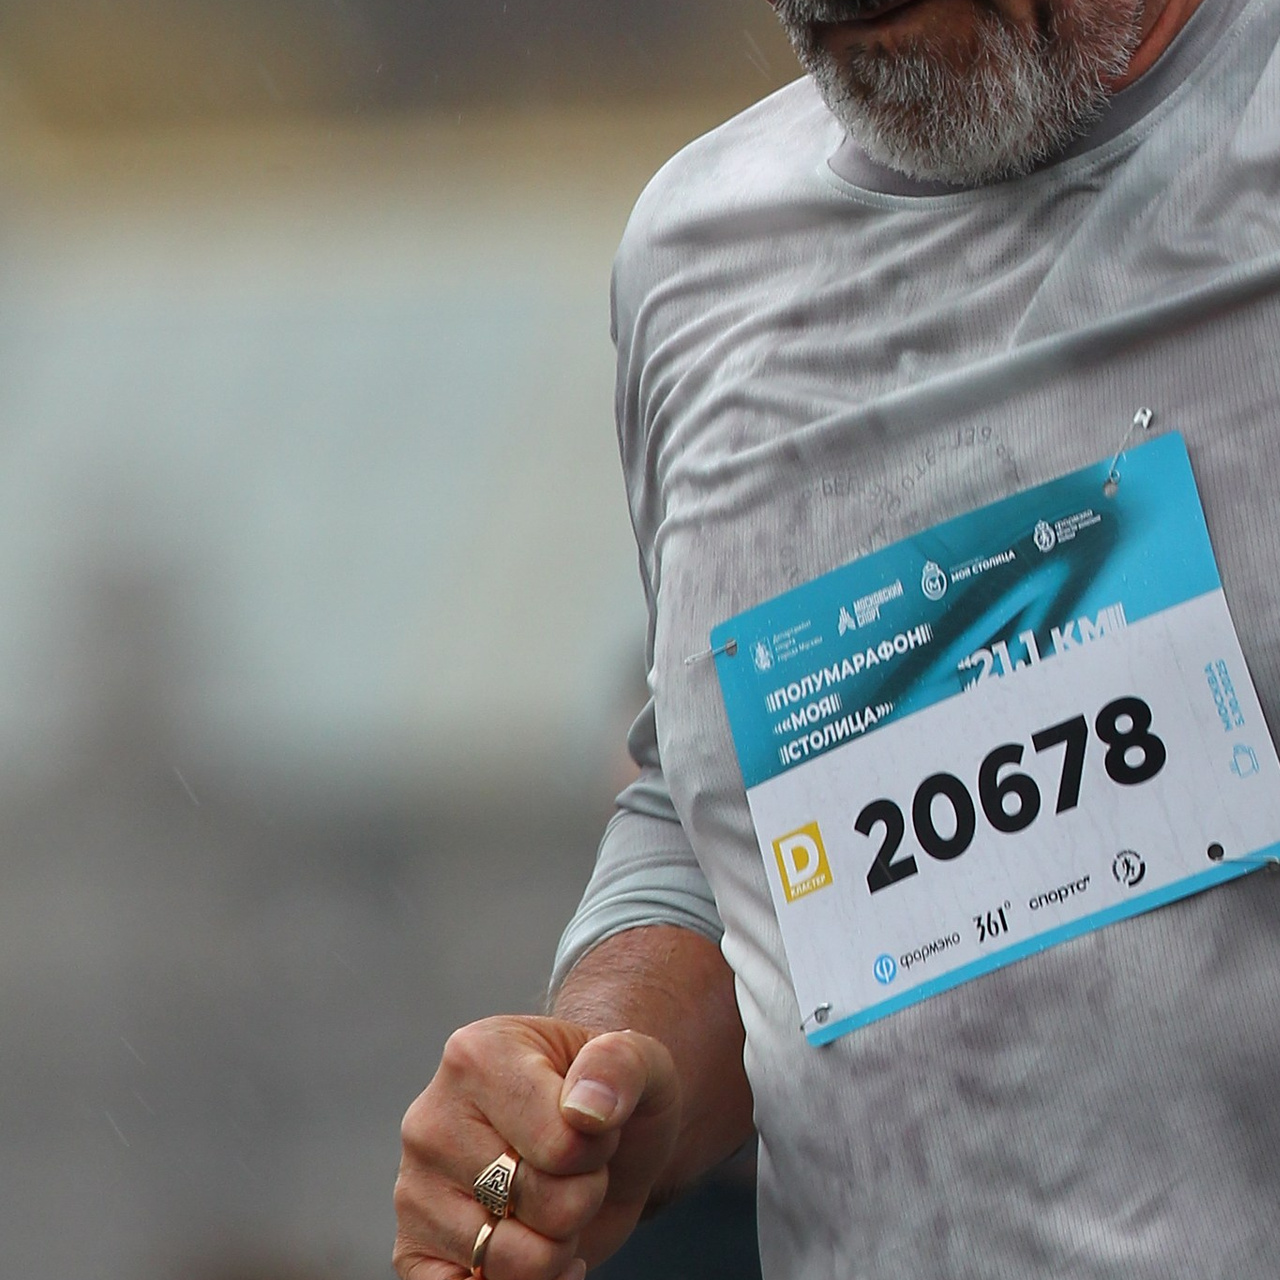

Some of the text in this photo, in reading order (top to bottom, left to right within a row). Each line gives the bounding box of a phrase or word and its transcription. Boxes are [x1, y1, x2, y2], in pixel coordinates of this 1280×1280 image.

[973, 549, 1016, 575] СТОЛИЦА
[853, 578, 904, 611] МОСКОВСКИЙ
[856, 605, 880, 628] СПОРТ
[854, 696, 1166, 895] 20678
[779, 833, 820, 887] D
